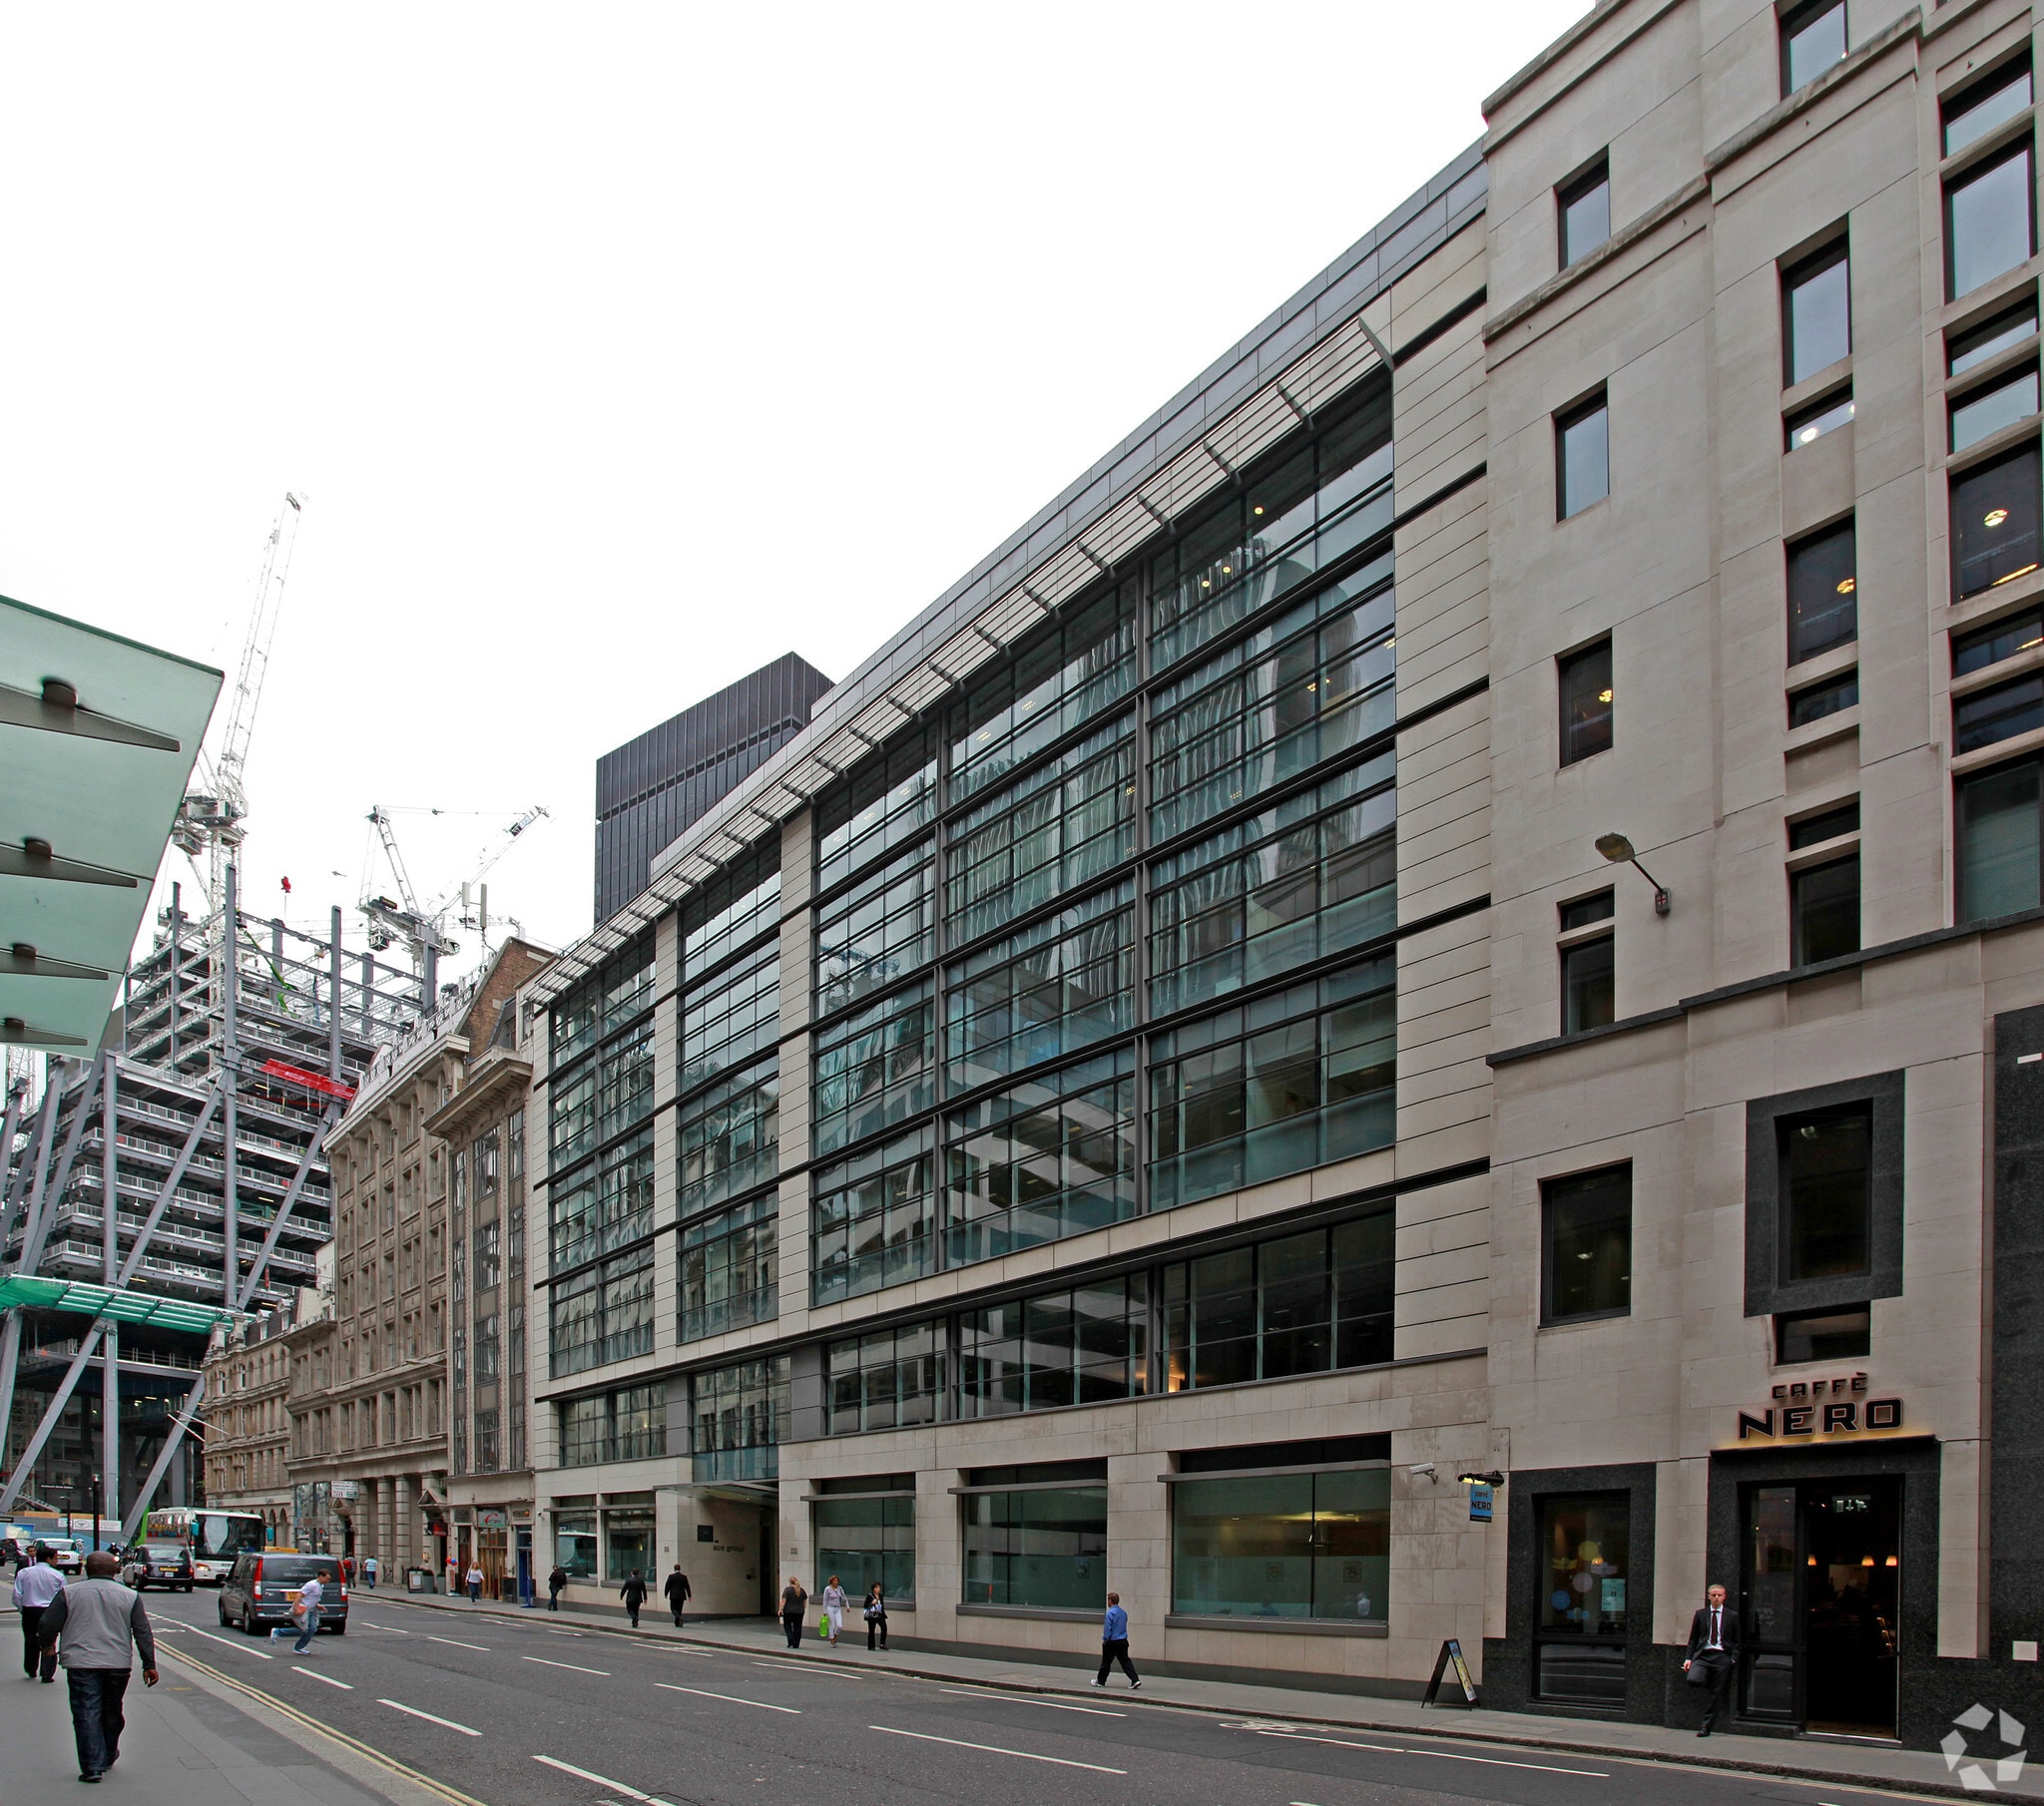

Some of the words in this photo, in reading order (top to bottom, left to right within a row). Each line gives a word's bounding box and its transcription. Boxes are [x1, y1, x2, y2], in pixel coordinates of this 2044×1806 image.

[1772, 1371, 1867, 1399] CAFFÈ
[1738, 1397, 1904, 1441] NERO
[1471, 1501, 1491, 1510] NERO
